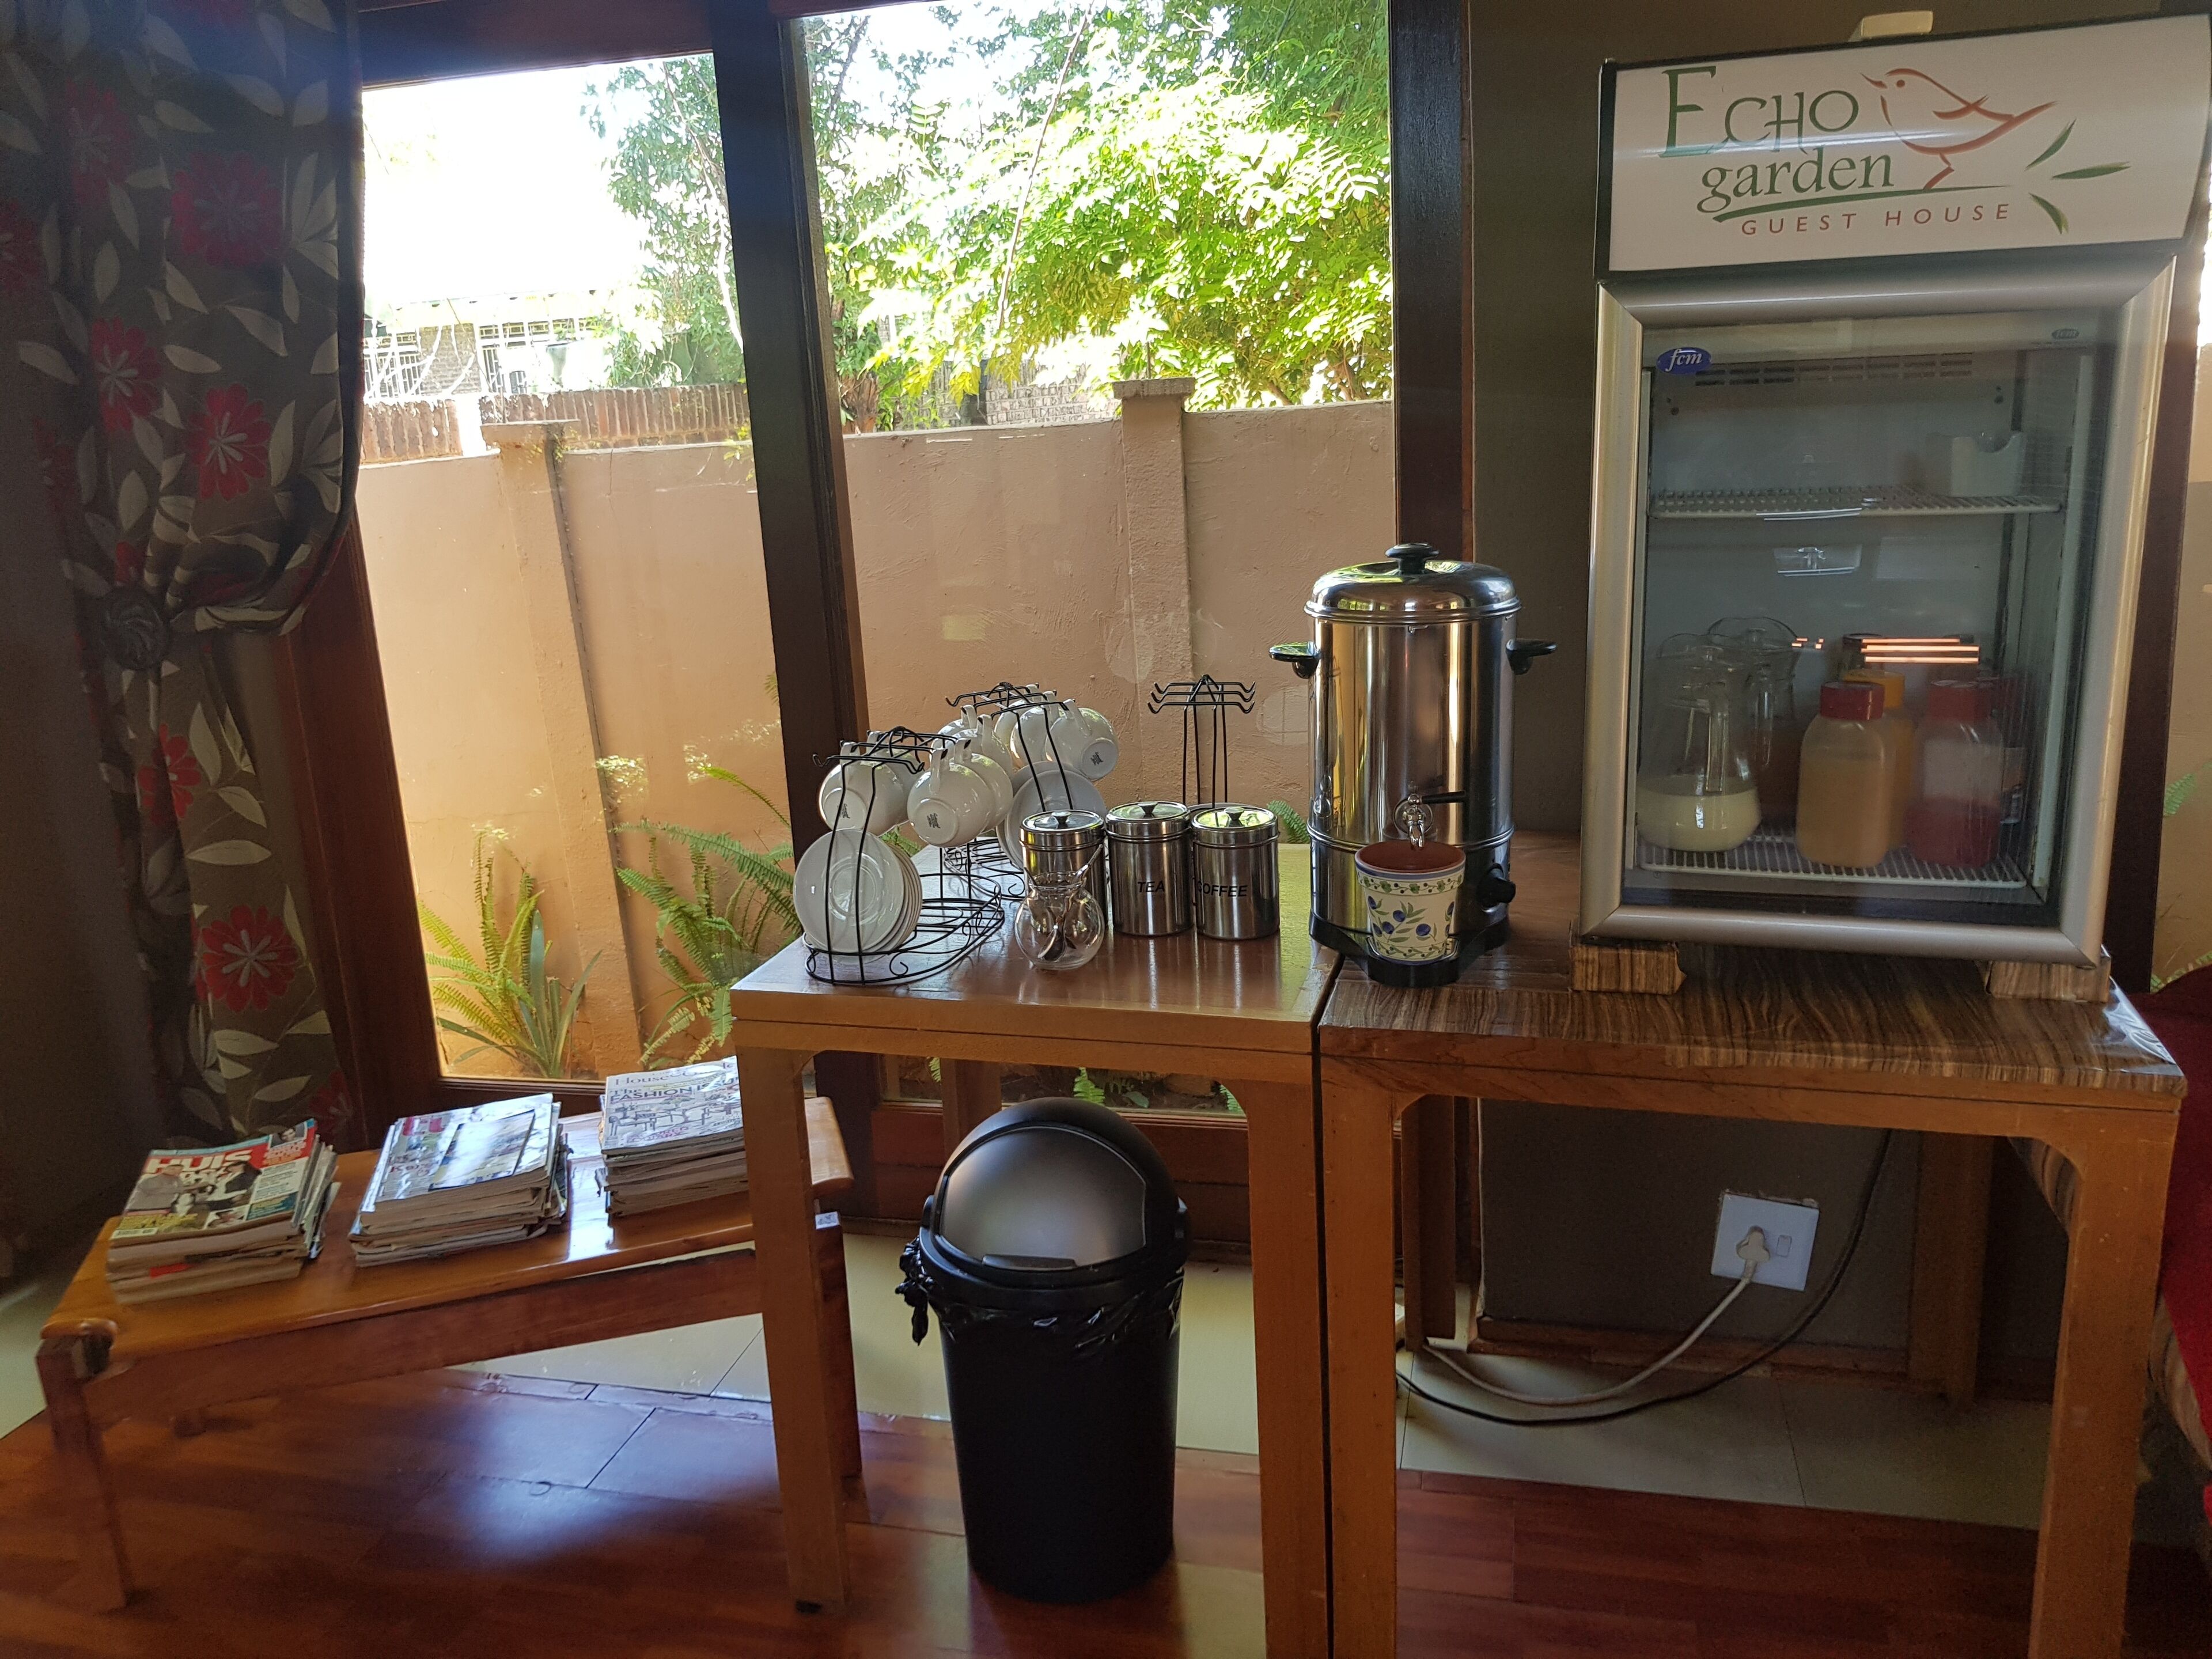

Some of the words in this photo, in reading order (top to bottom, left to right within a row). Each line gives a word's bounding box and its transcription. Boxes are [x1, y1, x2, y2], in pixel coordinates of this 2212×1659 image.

[1696, 147, 1895, 214] garden
[1741, 213, 1858, 236] GUEST
[1885, 203, 2010, 227] HOUSE
[1665, 348, 1702, 372] fcm
[1138, 880, 1165, 893] TEA
[1196, 880, 1248, 897] COFFEE
[611, 1086, 692, 1102] FASHION
[145, 1149, 253, 1175] HUIS
